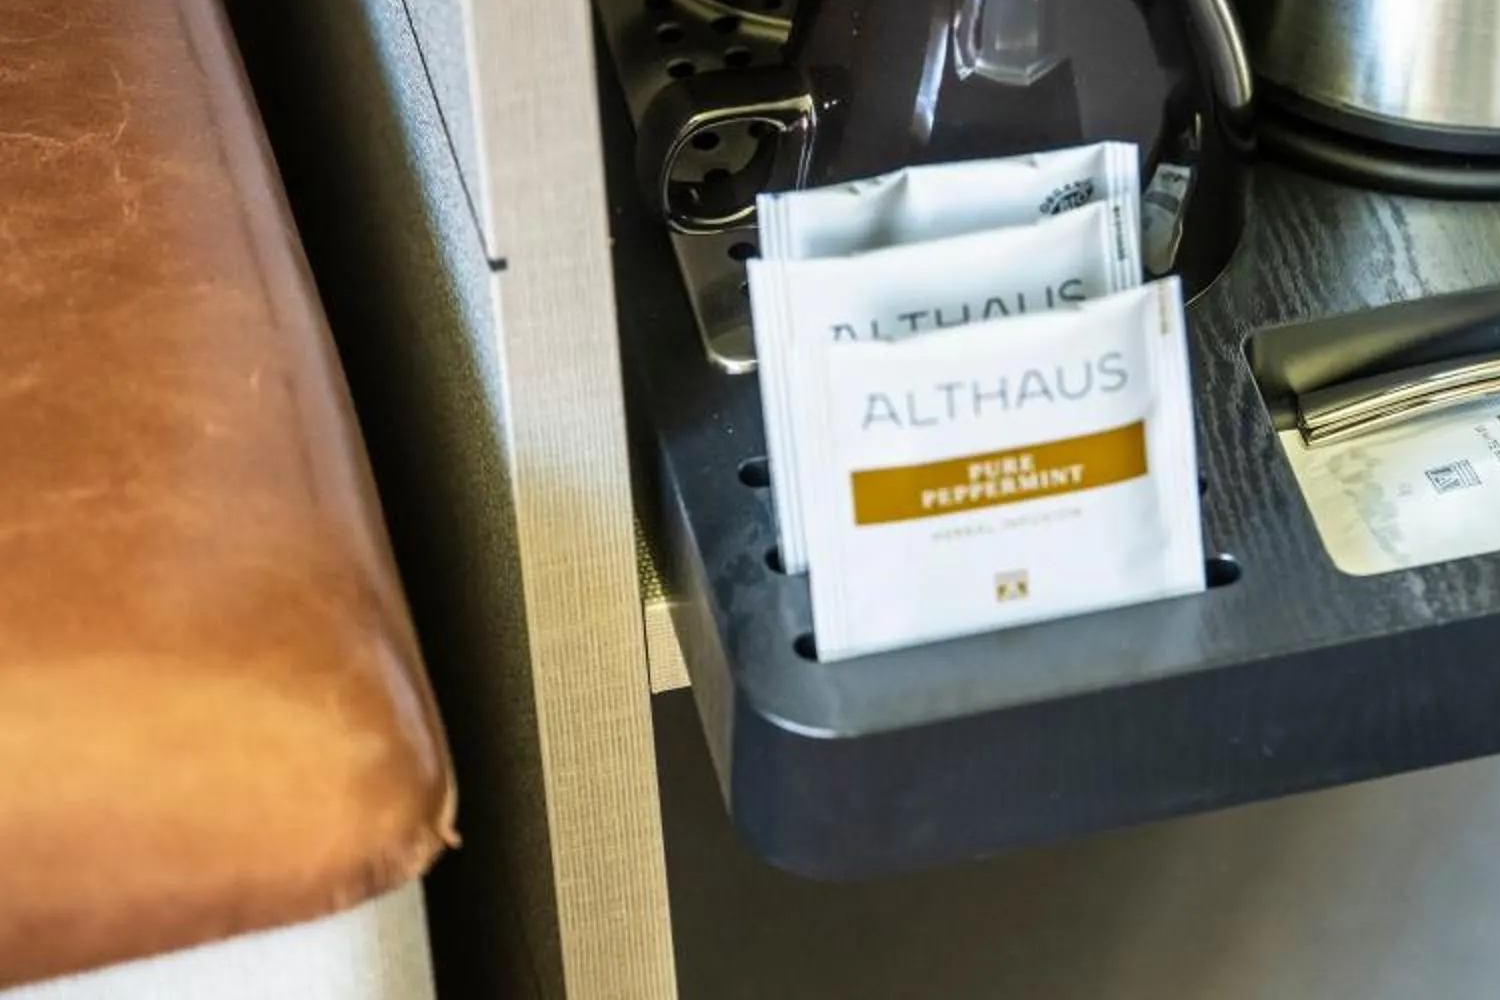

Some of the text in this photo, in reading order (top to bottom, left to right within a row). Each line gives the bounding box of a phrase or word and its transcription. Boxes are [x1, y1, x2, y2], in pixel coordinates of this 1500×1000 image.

[862, 352, 1129, 431] ALTHAUS
[921, 464, 1085, 509] PEPPERMINT
[968, 453, 1035, 483] PURE
